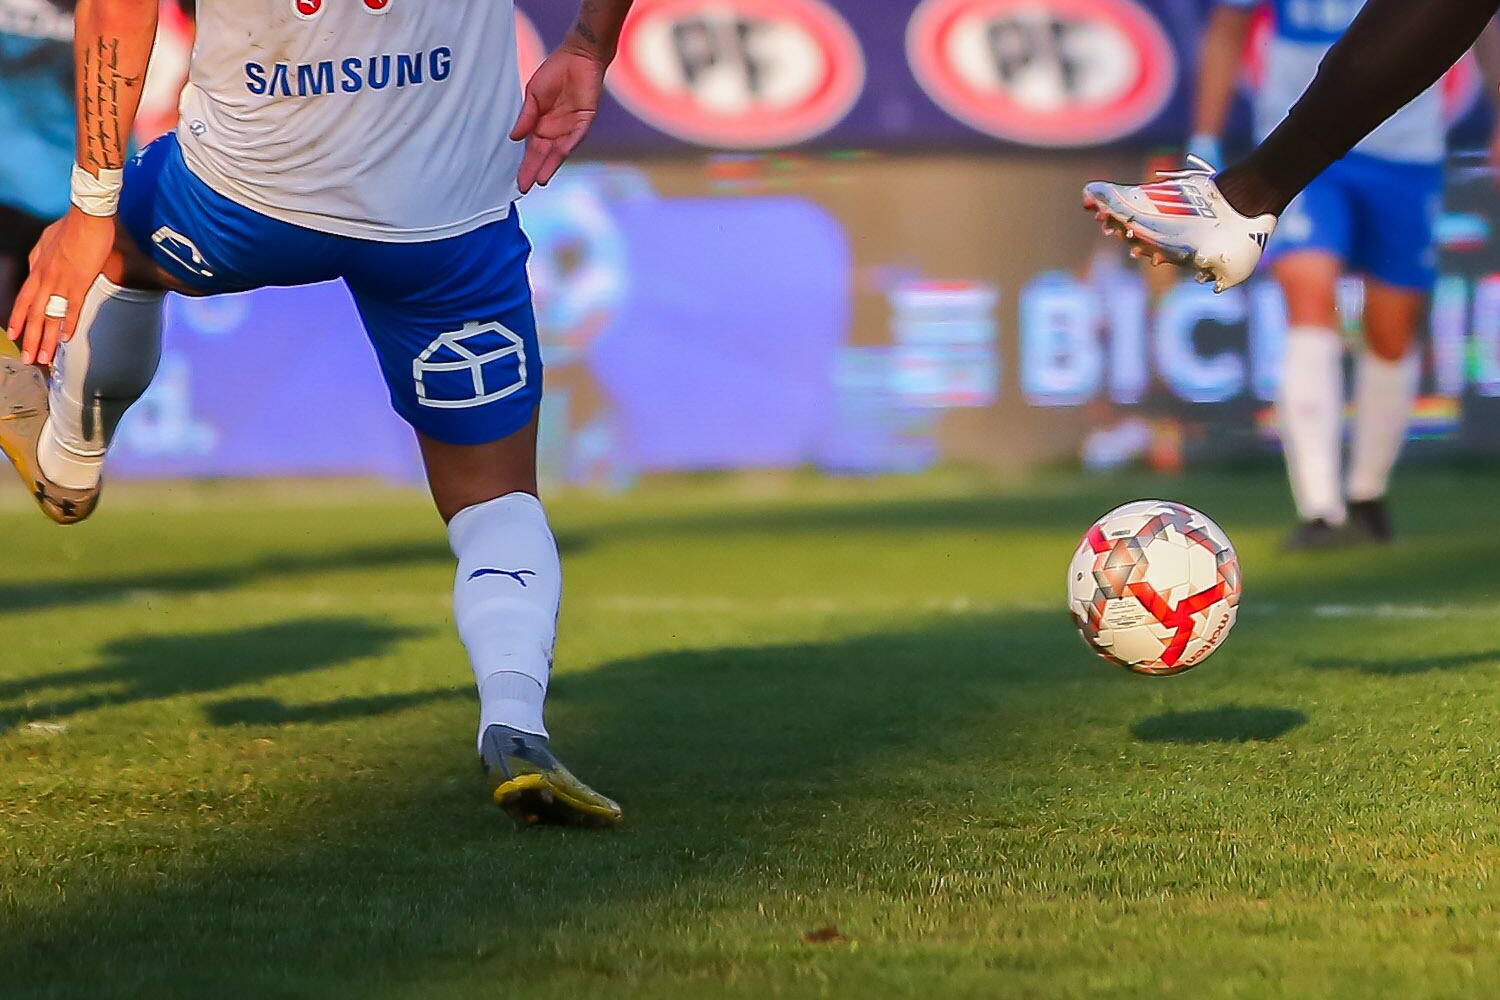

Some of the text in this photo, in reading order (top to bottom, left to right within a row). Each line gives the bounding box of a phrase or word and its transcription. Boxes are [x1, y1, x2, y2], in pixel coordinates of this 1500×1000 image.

[244, 45, 453, 99] SAMSUNG
[670, 15, 778, 82] PF
[988, 15, 1088, 84] PF
